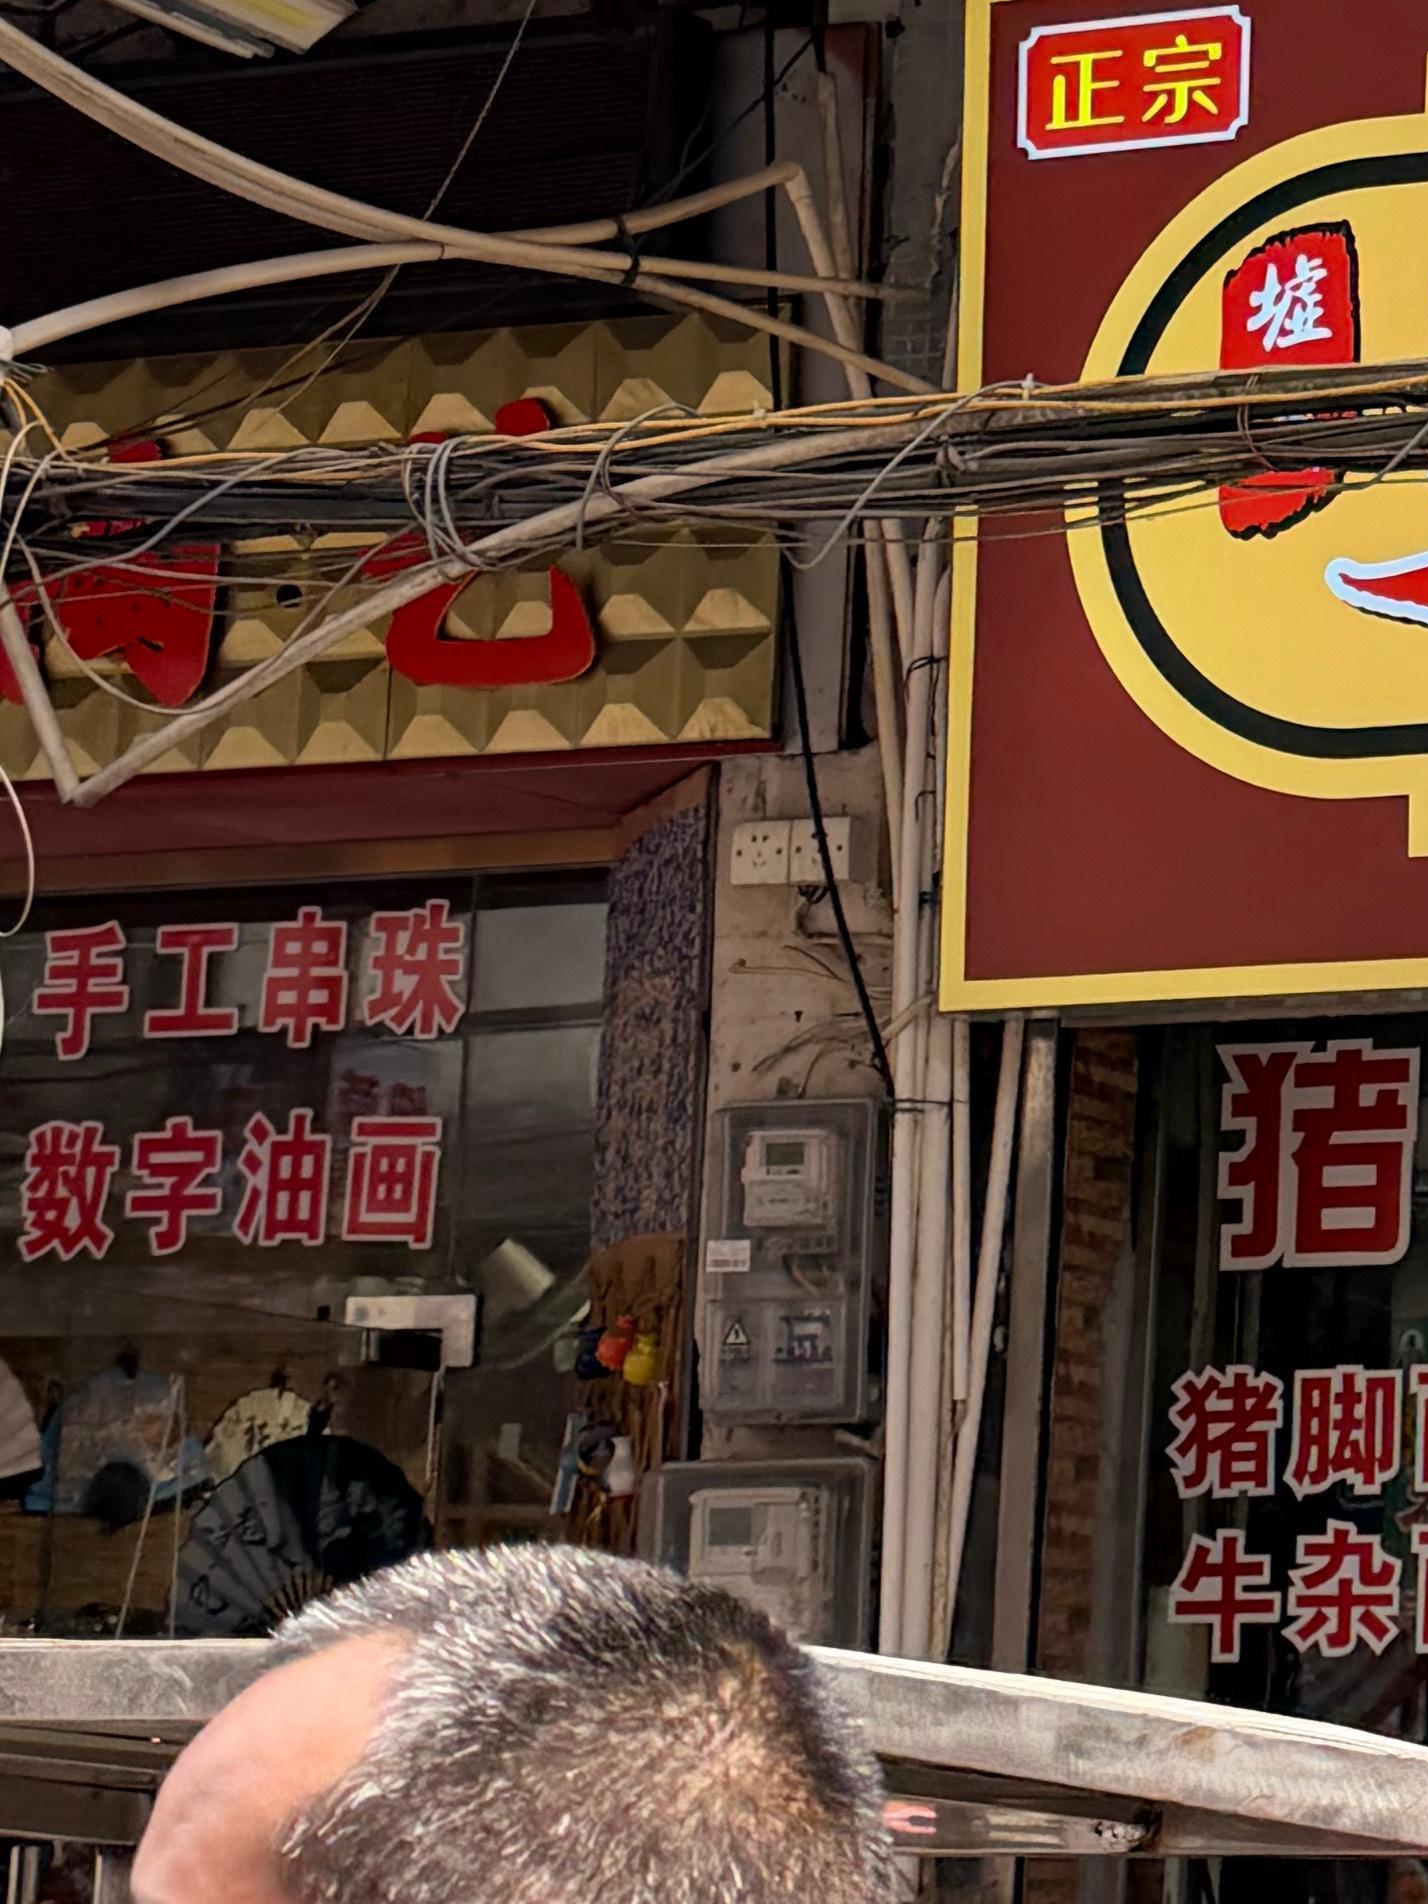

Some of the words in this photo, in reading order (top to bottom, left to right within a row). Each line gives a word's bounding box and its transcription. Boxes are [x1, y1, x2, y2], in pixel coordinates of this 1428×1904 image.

[1046, 34, 1223, 132] 正宗
[34, 899, 466, 1061] 手工串珠
[19, 1107, 443, 1263] 数字油画
